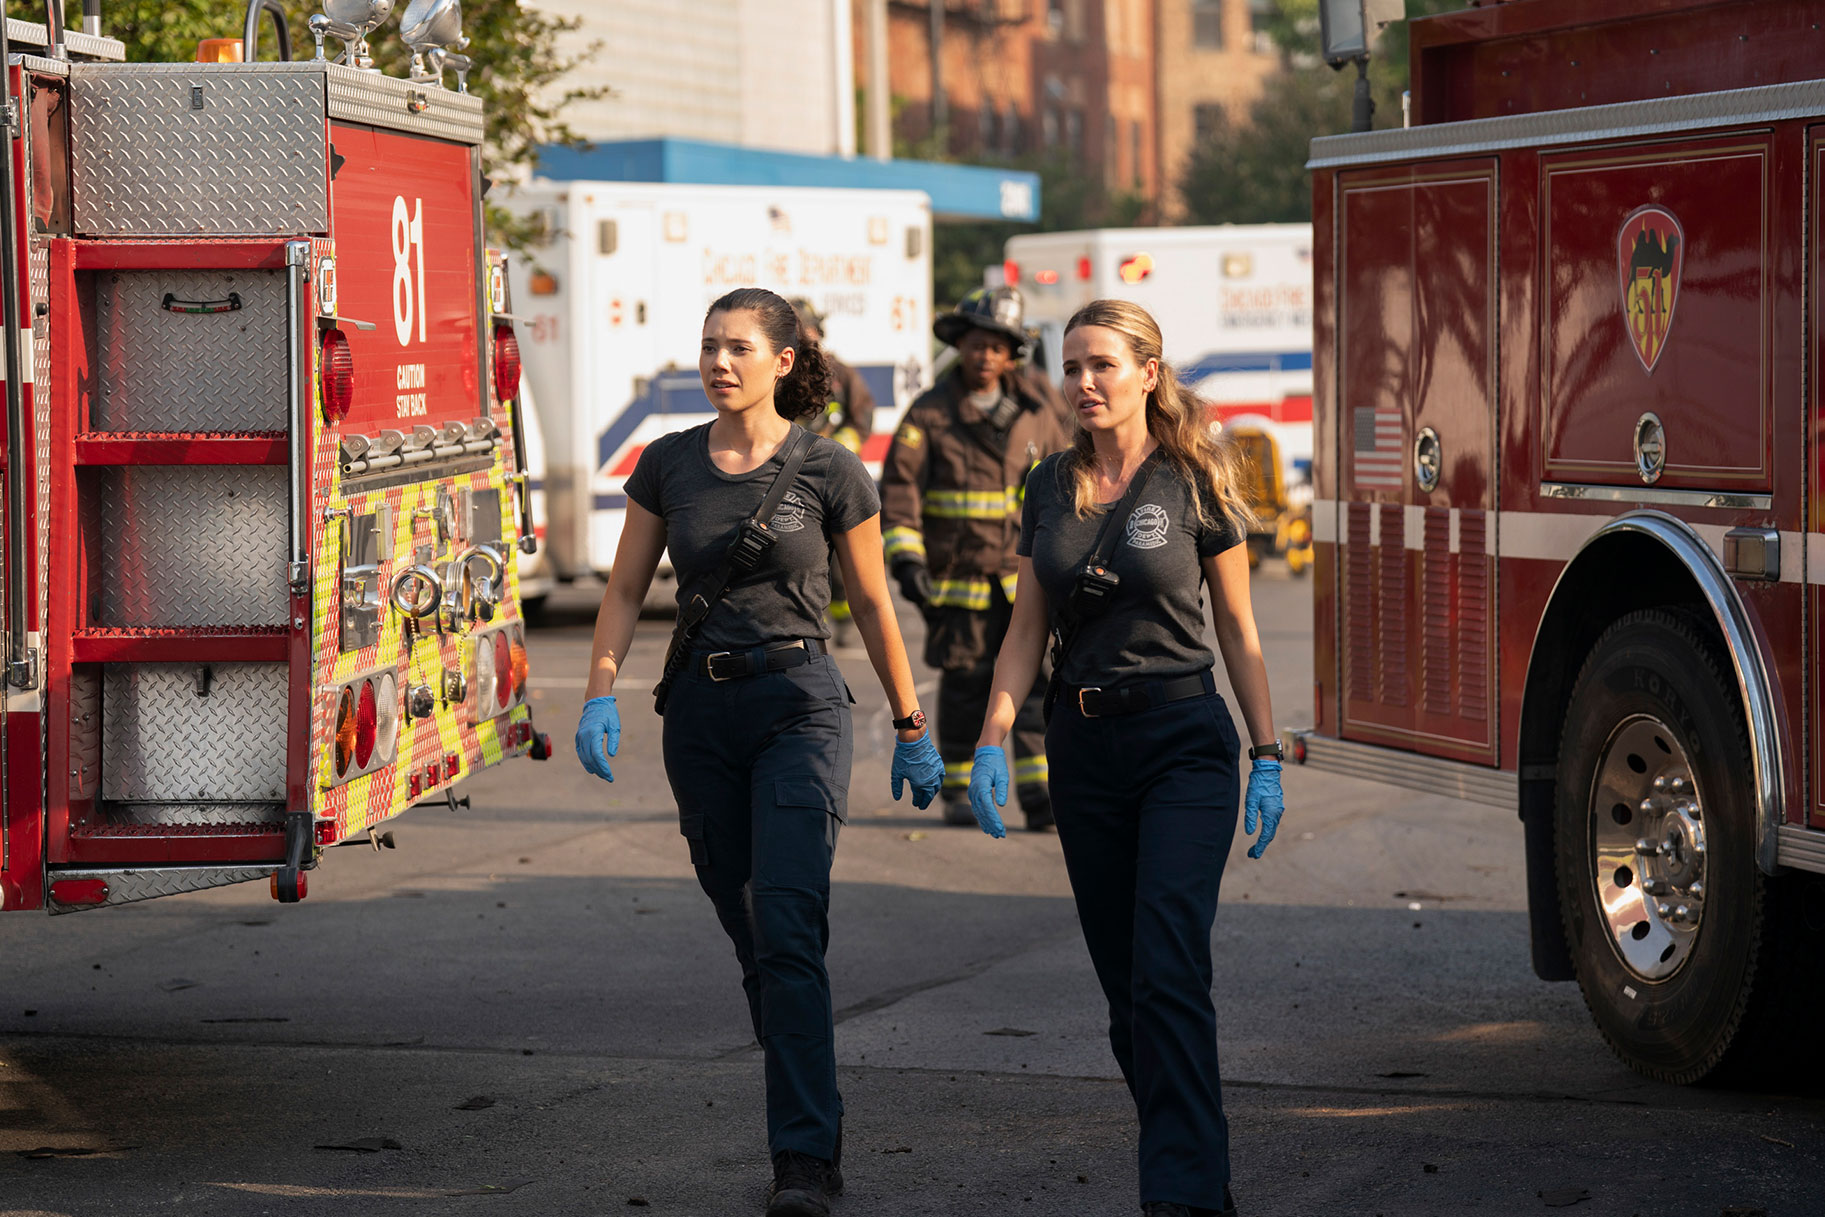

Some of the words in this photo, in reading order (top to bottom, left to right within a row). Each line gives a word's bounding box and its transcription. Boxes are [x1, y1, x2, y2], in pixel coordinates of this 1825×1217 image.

[391, 195, 427, 347] 81
[396, 363, 425, 390] CAUTION
[396, 394, 410, 419] STAY
[410, 392, 427, 417] BACK
[1136, 518, 1157, 526] CHICAGO
